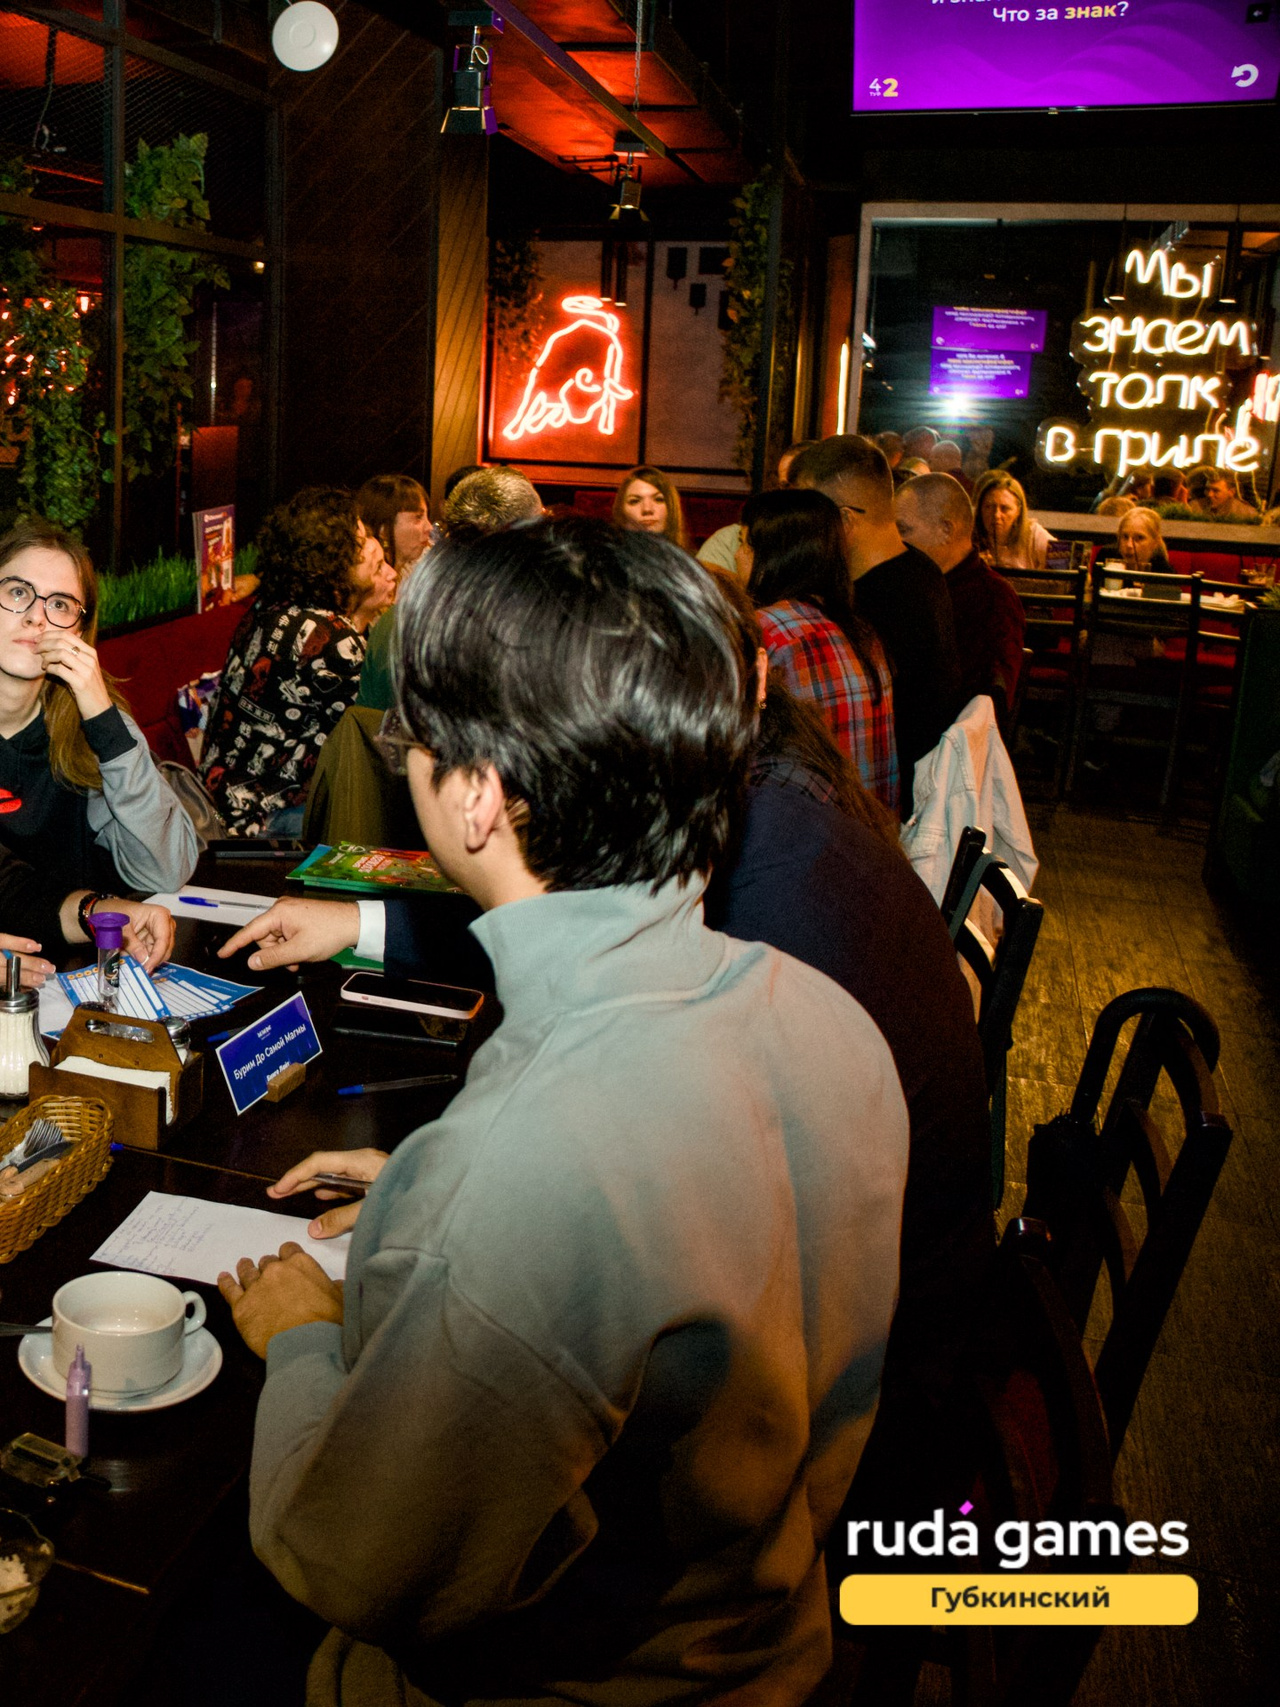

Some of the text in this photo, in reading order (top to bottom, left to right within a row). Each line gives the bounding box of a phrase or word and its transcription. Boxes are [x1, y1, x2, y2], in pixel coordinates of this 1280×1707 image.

[993, 1, 1129, 22] Что за знак?
[882, 78, 898, 97] 2
[1124, 249, 1214, 299] Мы
[1081, 315, 1251, 356] знаем
[1088, 371, 1221, 410] толк
[1094, 428, 1260, 479] гриле
[233, 1061, 255, 1080] Бурим
[255, 1053, 265, 1067] До
[264, 1039, 285, 1058] Самой
[284, 1023, 307, 1043] Магмы
